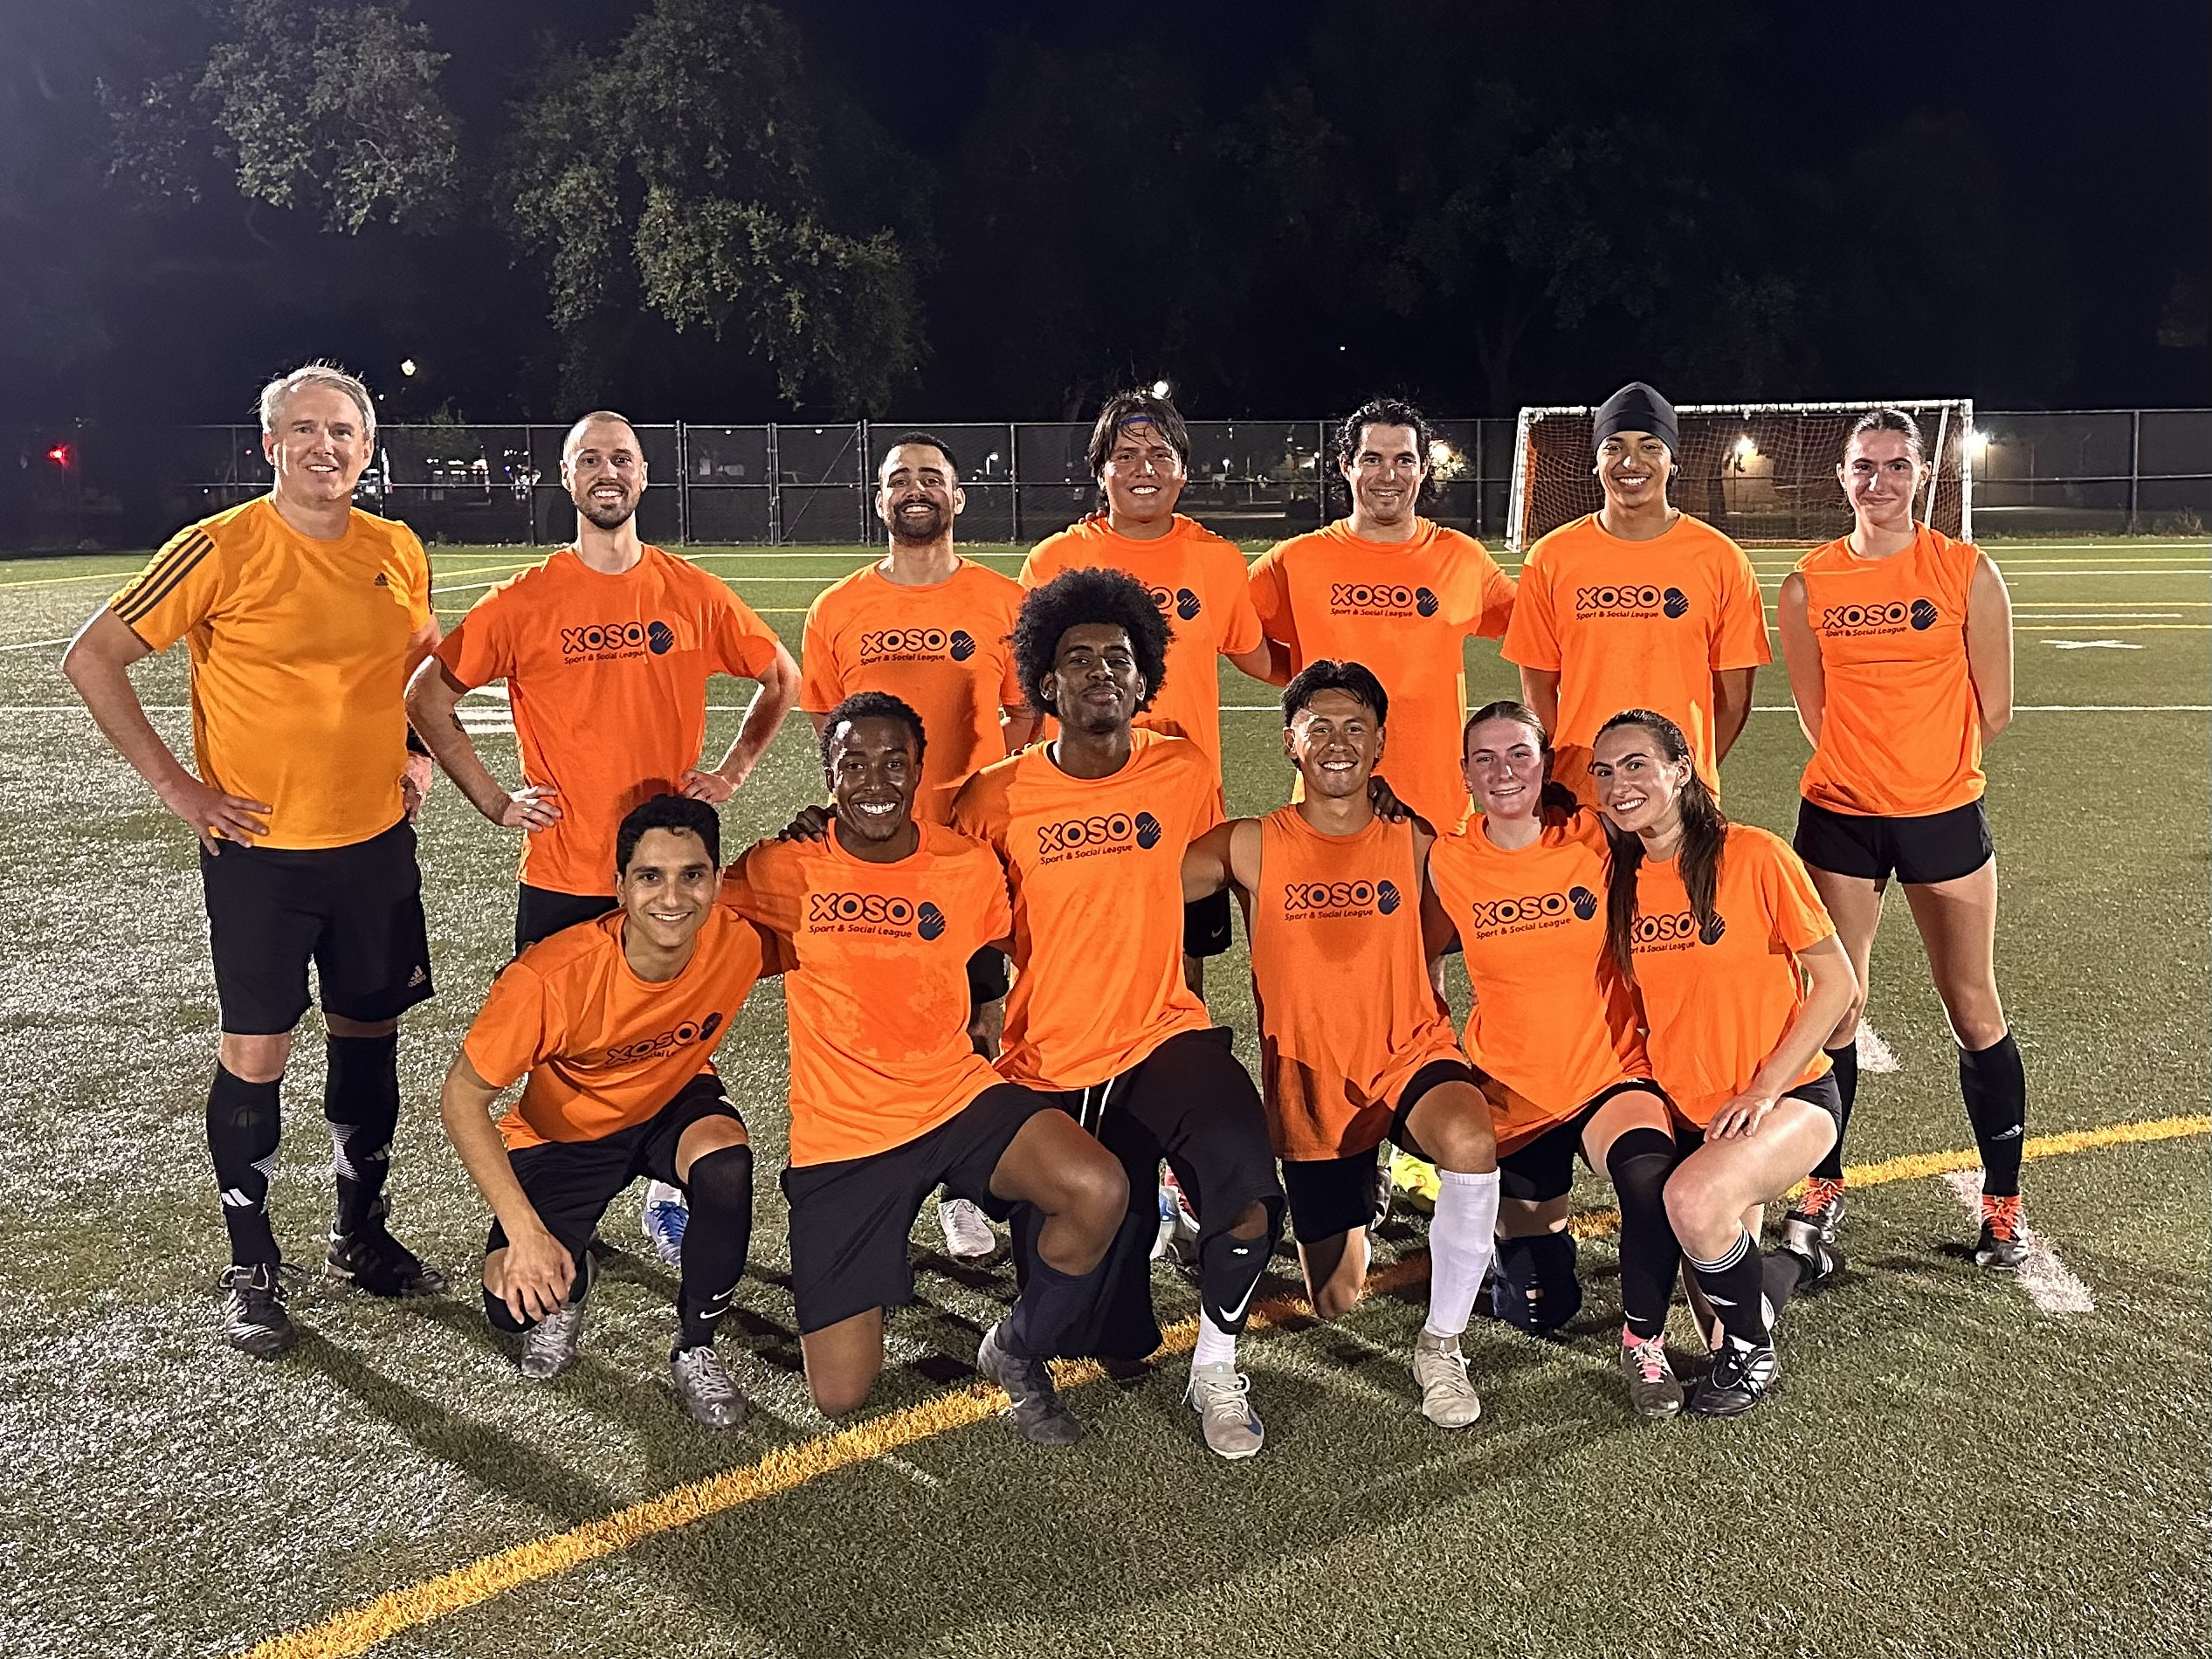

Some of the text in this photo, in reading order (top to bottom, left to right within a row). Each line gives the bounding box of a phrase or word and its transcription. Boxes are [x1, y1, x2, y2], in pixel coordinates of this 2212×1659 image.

[1331, 583, 1413, 609] XOSO
[1575, 585, 1661, 610] XOSO
[1576, 611, 1596, 621] Sport
[1823, 602, 1907, 630] XOSO
[561, 622, 645, 654] XOSO
[860, 628, 948, 656] XOSO
[1852, 628, 1876, 637] Social
[1878, 626, 1907, 636] League
[564, 657, 585, 665] Sport
[860, 656, 881, 666] Sport
[1037, 812, 1133, 855] XOSO
[1040, 856, 1064, 865] Sport
[1075, 849, 1100, 859] Social
[1103, 843, 1133, 855] League
[1285, 880, 1375, 911] XOSO
[809, 892, 914, 926] XOSO
[1285, 912, 1307, 921] Sport
[1344, 909, 1373, 918] League
[1472, 893, 1568, 928] XOSO
[809, 924, 834, 934] Sport
[848, 925, 876, 933] Social
[878, 927, 913, 940] League
[1476, 929, 1498, 940] Sport
[1510, 924, 1535, 934] Social
[1539, 918, 1572, 929] League
[1647, 943, 1667, 953] Social
[1669, 941, 1695, 951] League
[605, 1021, 699, 1064] XOSO
